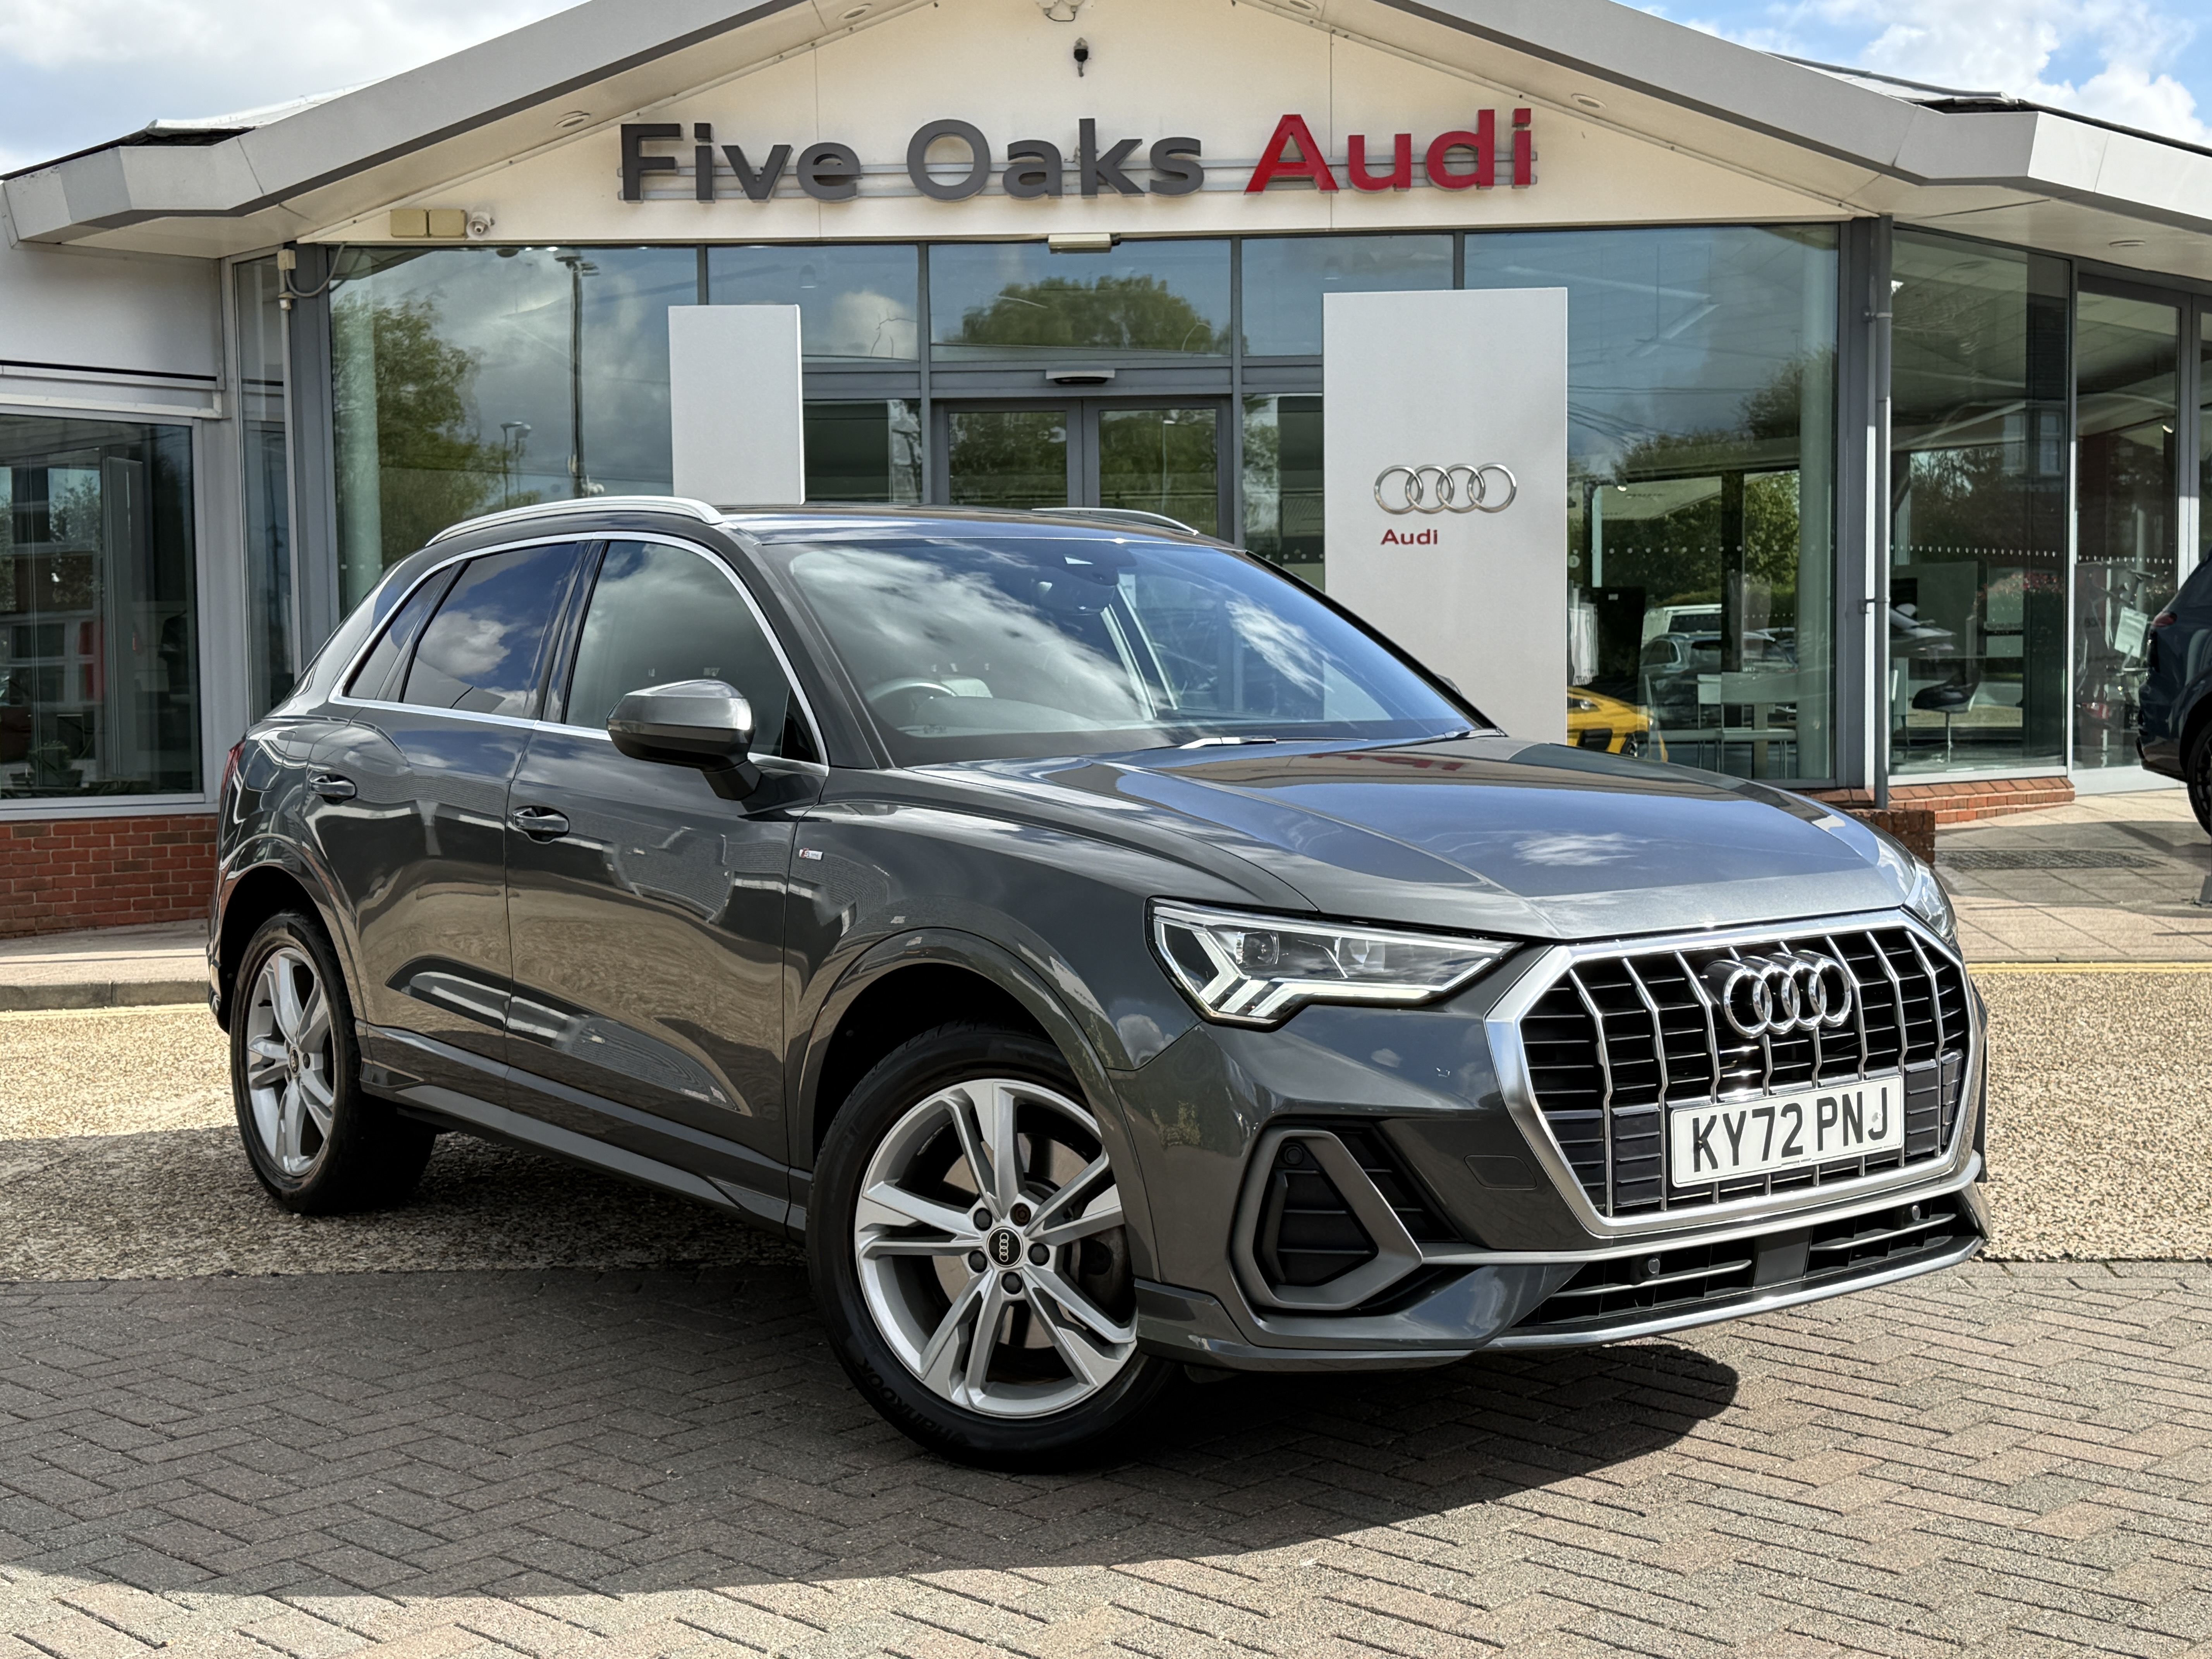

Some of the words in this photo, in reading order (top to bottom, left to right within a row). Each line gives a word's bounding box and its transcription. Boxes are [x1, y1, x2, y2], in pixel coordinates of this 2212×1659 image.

[620, 122, 860, 202] Five
[907, 118, 1204, 202] Oaks
[1244, 108, 1532, 195] Audi
[1380, 529, 1438, 545] Audi
[1692, 1102, 1803, 1173] KY72
[1816, 1087, 1887, 1152] PNJ
